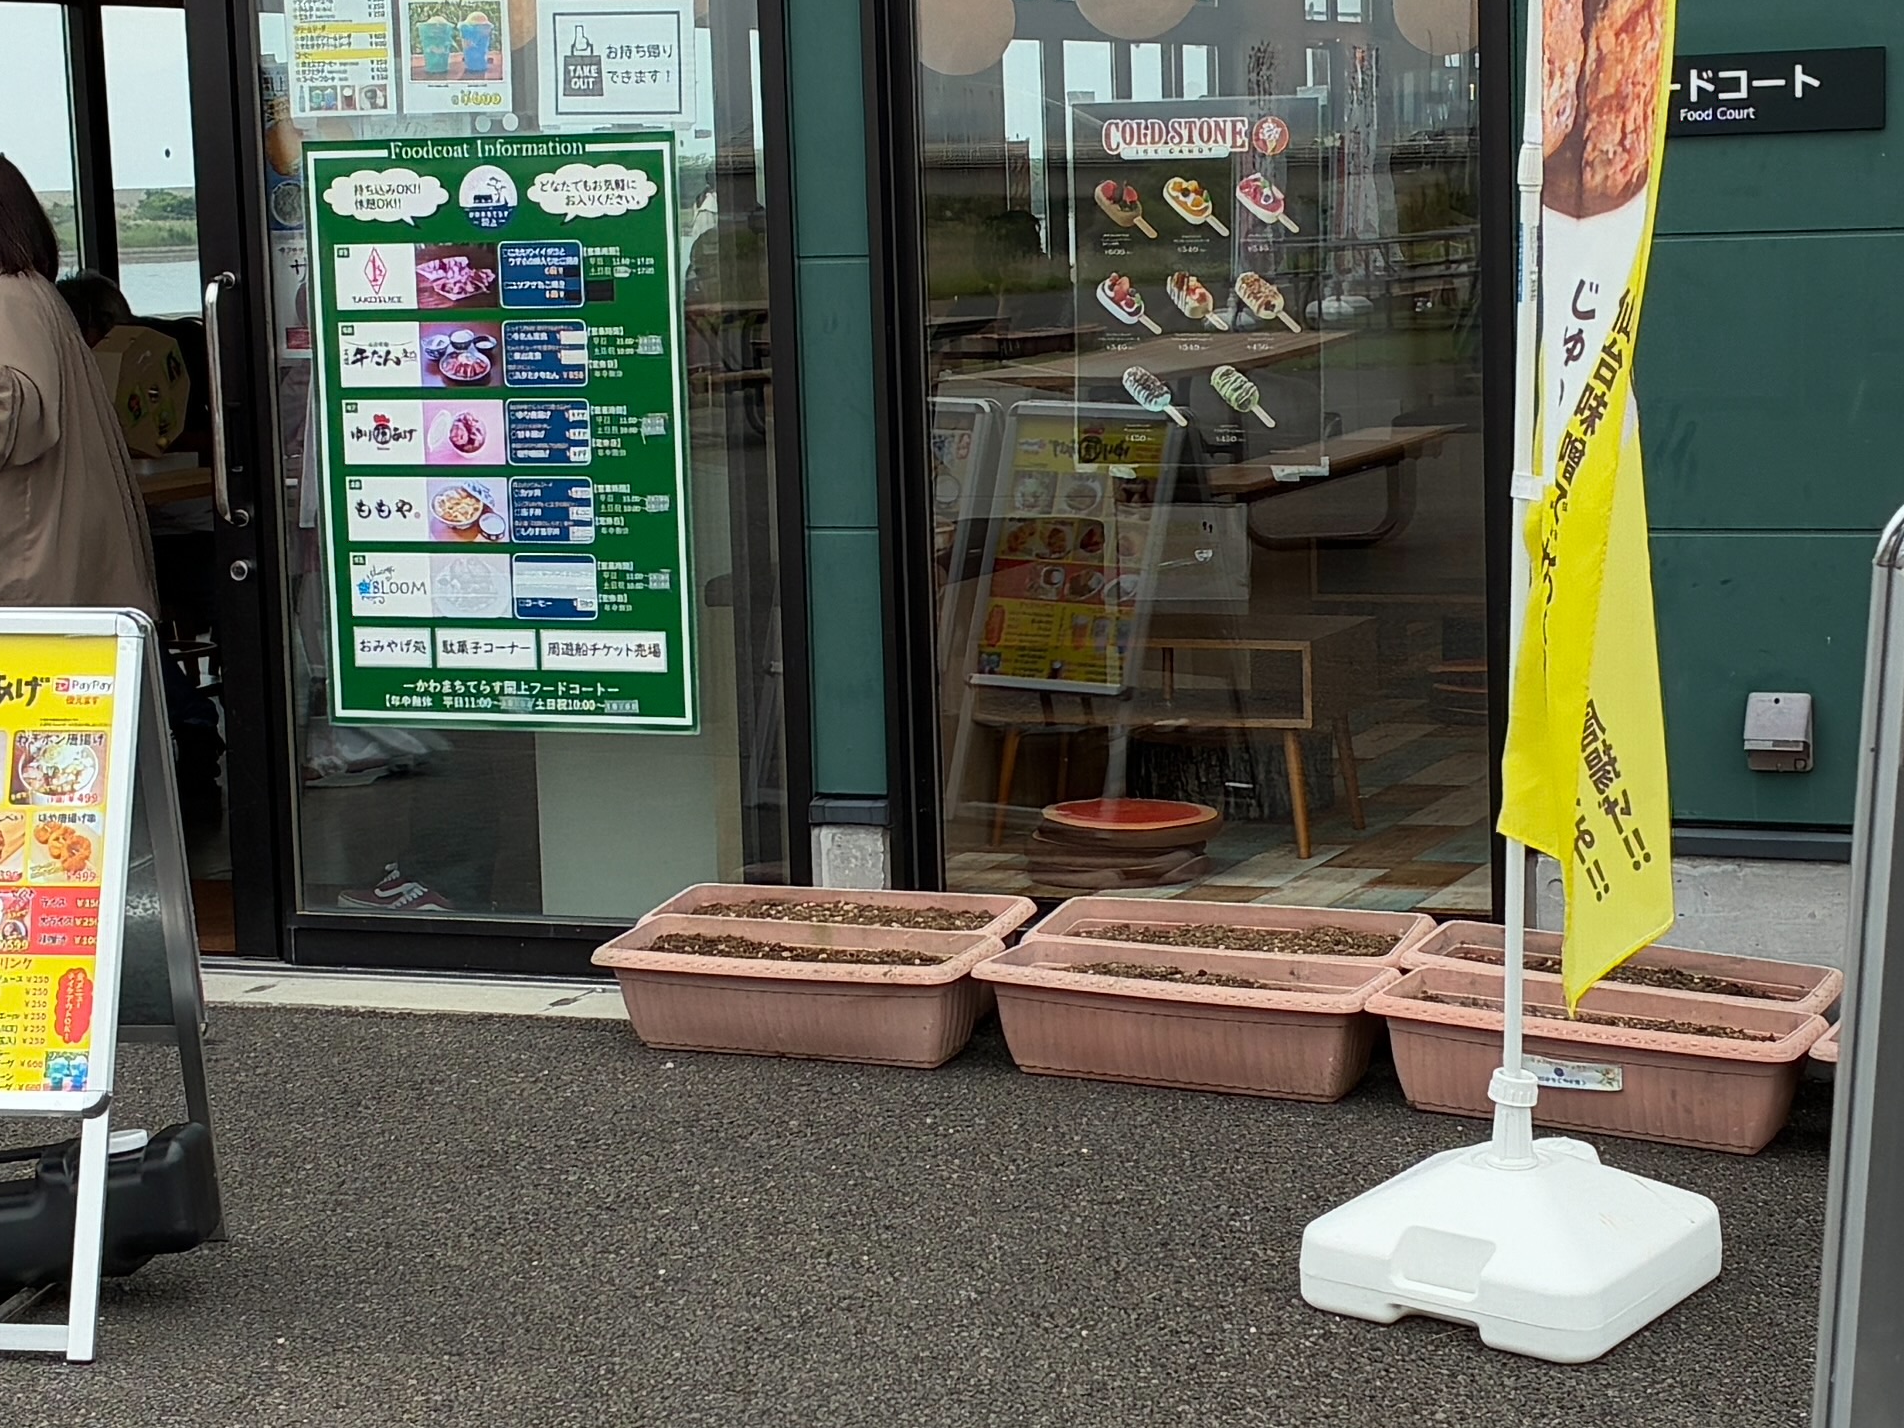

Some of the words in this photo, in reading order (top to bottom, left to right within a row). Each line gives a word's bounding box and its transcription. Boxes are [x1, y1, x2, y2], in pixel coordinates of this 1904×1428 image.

[569, 65, 598, 77] TAKE
[570, 78, 595, 90] OUT
[1680, 108, 1712, 121] Food
[1717, 107, 1755, 120] Court
[390, 141, 469, 159] Foodcoat
[477, 139, 583, 157] Information
